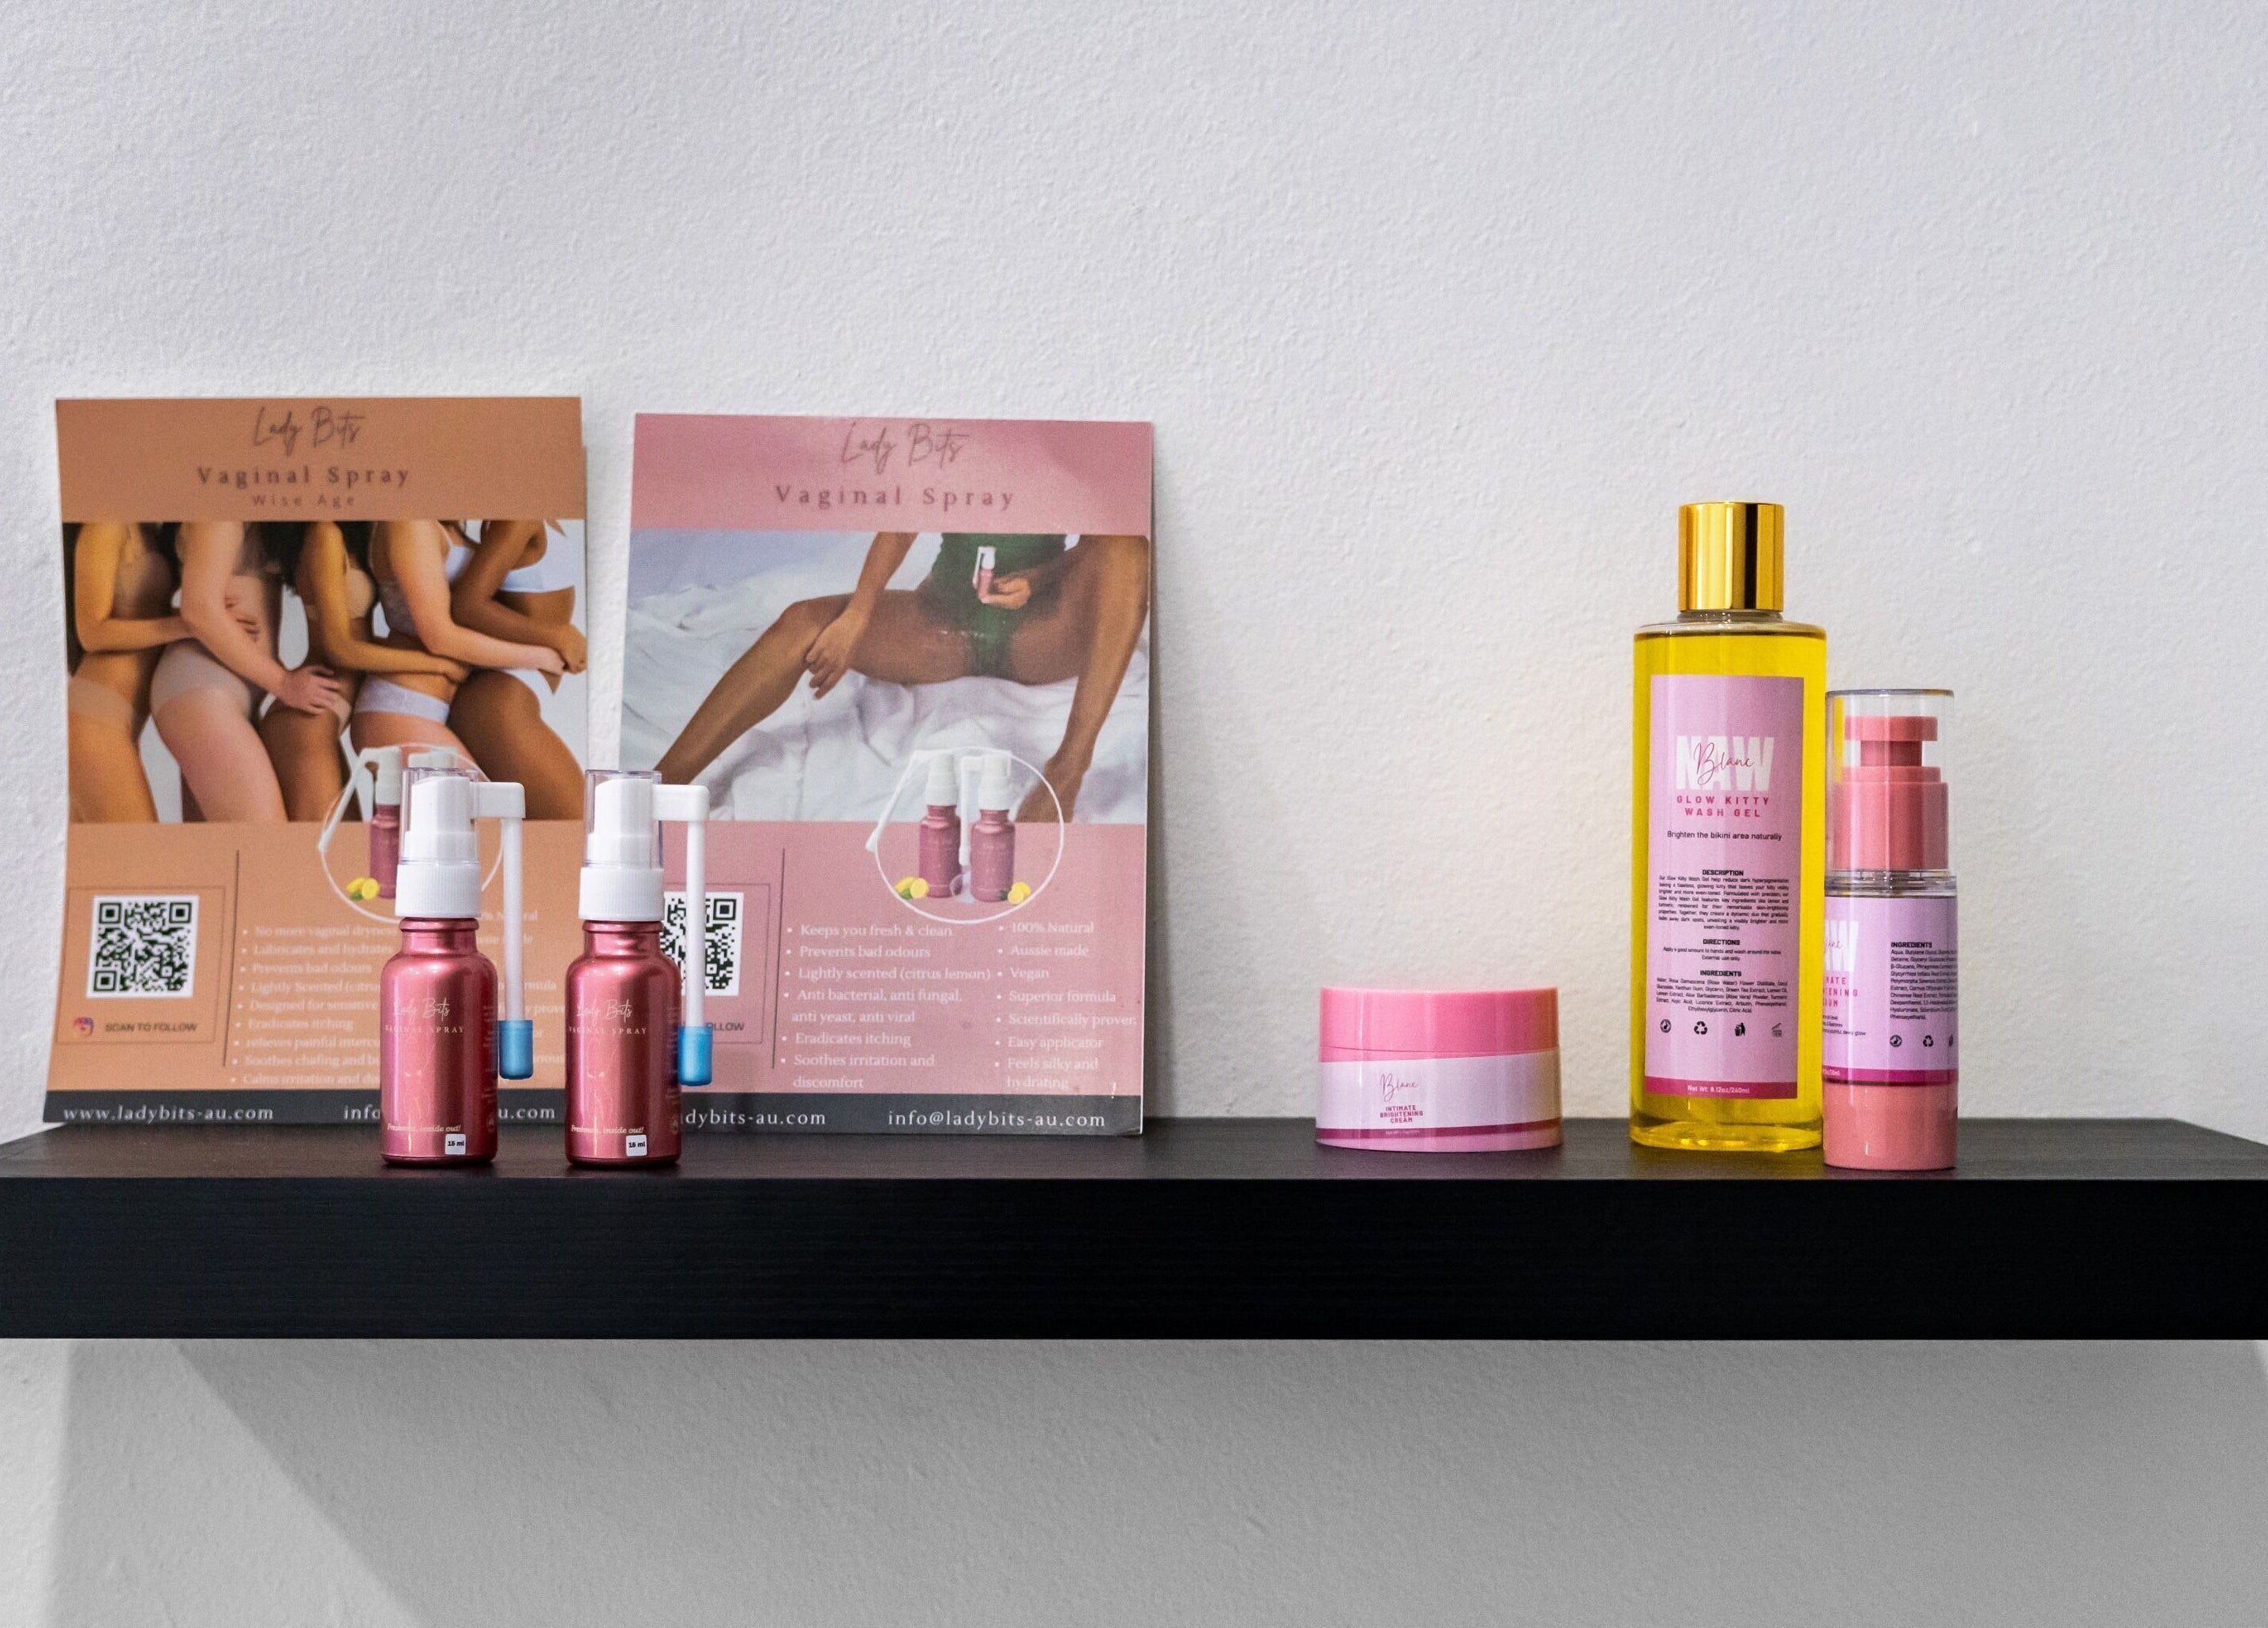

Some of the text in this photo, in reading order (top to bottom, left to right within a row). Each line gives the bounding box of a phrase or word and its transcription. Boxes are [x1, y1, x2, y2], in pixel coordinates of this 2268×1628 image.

[252, 405, 366, 457] Lady Bits
[841, 421, 971, 475] Lady Bits
[197, 466, 409, 491] Vaginal Spray
[252, 494, 355, 509] Wise Age
[774, 484, 1013, 513] Vaginal Spray
[1675, 735, 1775, 792] NAW
[1693, 742, 1755, 786] Blanc
[1677, 795, 1770, 806] GLOW KITTY
[1684, 807, 1761, 818] WASH GEL
[1667, 830, 1695, 840] Brighten
[1751, 833, 1782, 842] naturally
[800, 923, 953, 940] Keeps you fresh & clean
[1012, 921, 1095, 934] 100% Natural
[798, 946, 931, 957] Prevents bad odours
[1010, 944, 1090, 957] Aussie made
[798, 967, 991, 982] Lightly scented (citrus lemon)
[1010, 967, 1050, 981] Vegan
[797, 988, 825, 1001] Anti
[890, 989, 915, 1001] anti
[1008, 990, 1117, 1005] Superior formula
[791, 1011, 817, 1023] anti
[858, 1011, 884, 1023] anti
[887, 1010, 916, 1023] viral
[1008, 1013, 1090, 1027] Scientifically
[105, 1023, 198, 1032] SCAN TO FOLLOW
[795, 1032, 911, 1049] Eradicates itching
[1008, 1036, 1103, 1051] Easy applicator
[794, 1054, 935, 1067] Soothes irritation and
[1007, 1057, 1098, 1072] Feels silky and
[792, 1076, 864, 1088] discomfort
[1006, 1076, 1068, 1090] hydrating
[63, 1104, 274, 1124] www.ladybits-au.com
[685, 1108, 826, 1129] dybits-au.com
[888, 1109, 1106, 1130] info@ladybits-au.com
